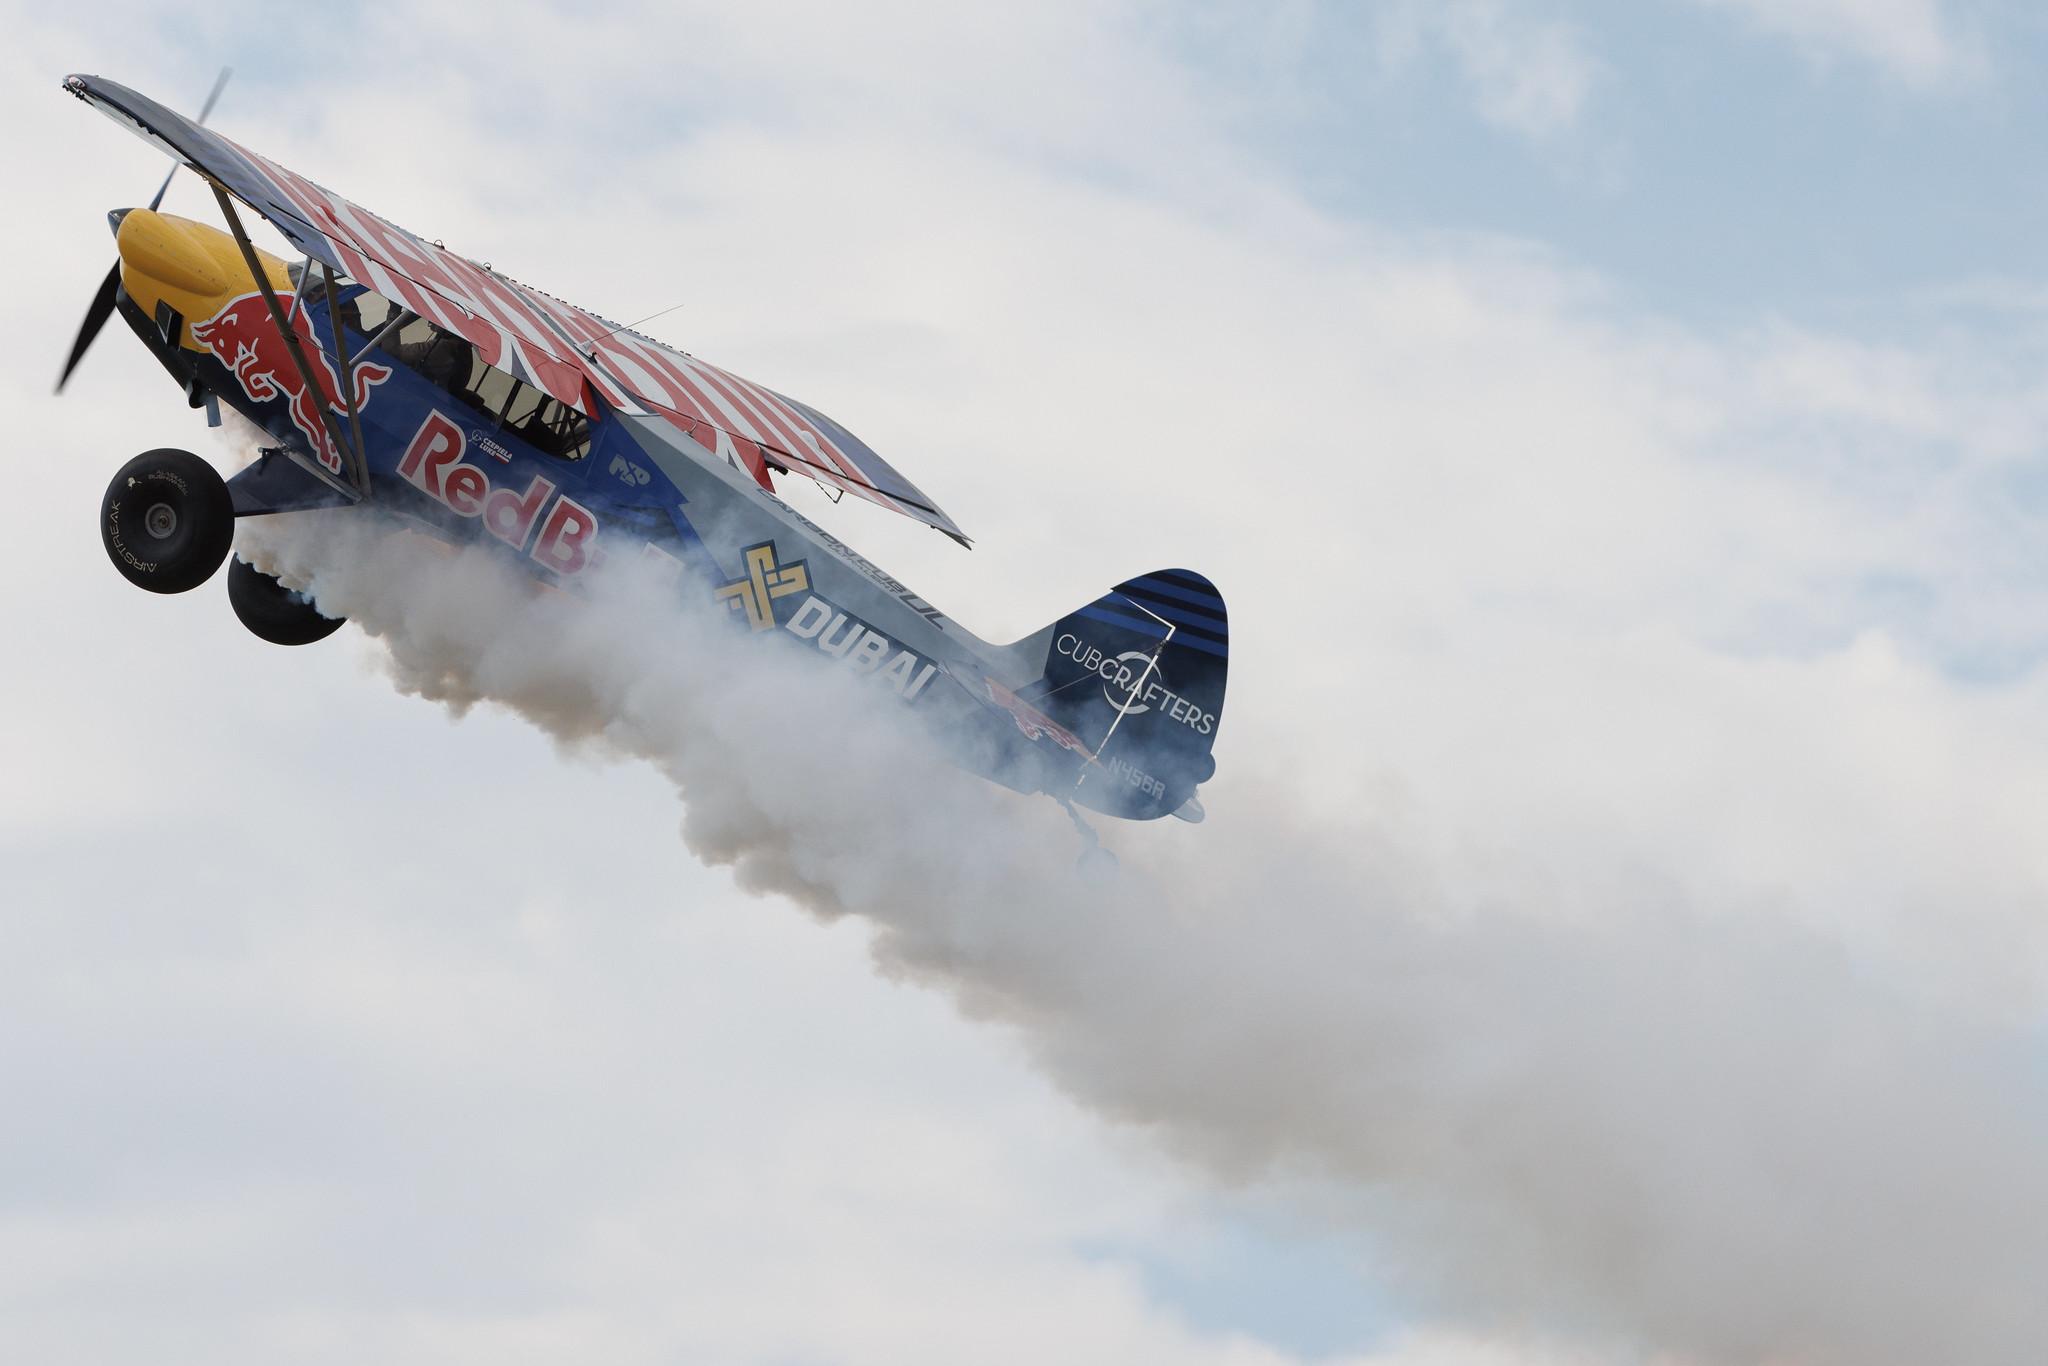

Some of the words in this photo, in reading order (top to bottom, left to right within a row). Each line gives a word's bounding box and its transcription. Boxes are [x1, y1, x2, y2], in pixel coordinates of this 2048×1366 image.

[395, 408, 556, 552] Red
[482, 437, 513, 460] CZEPIELA
[109, 499, 158, 573] AIRSTREAK
[785, 595, 937, 701] DUBAI
[1057, 633, 1215, 735] CUBCRAFTERS
[1108, 756, 1166, 800] N456R
